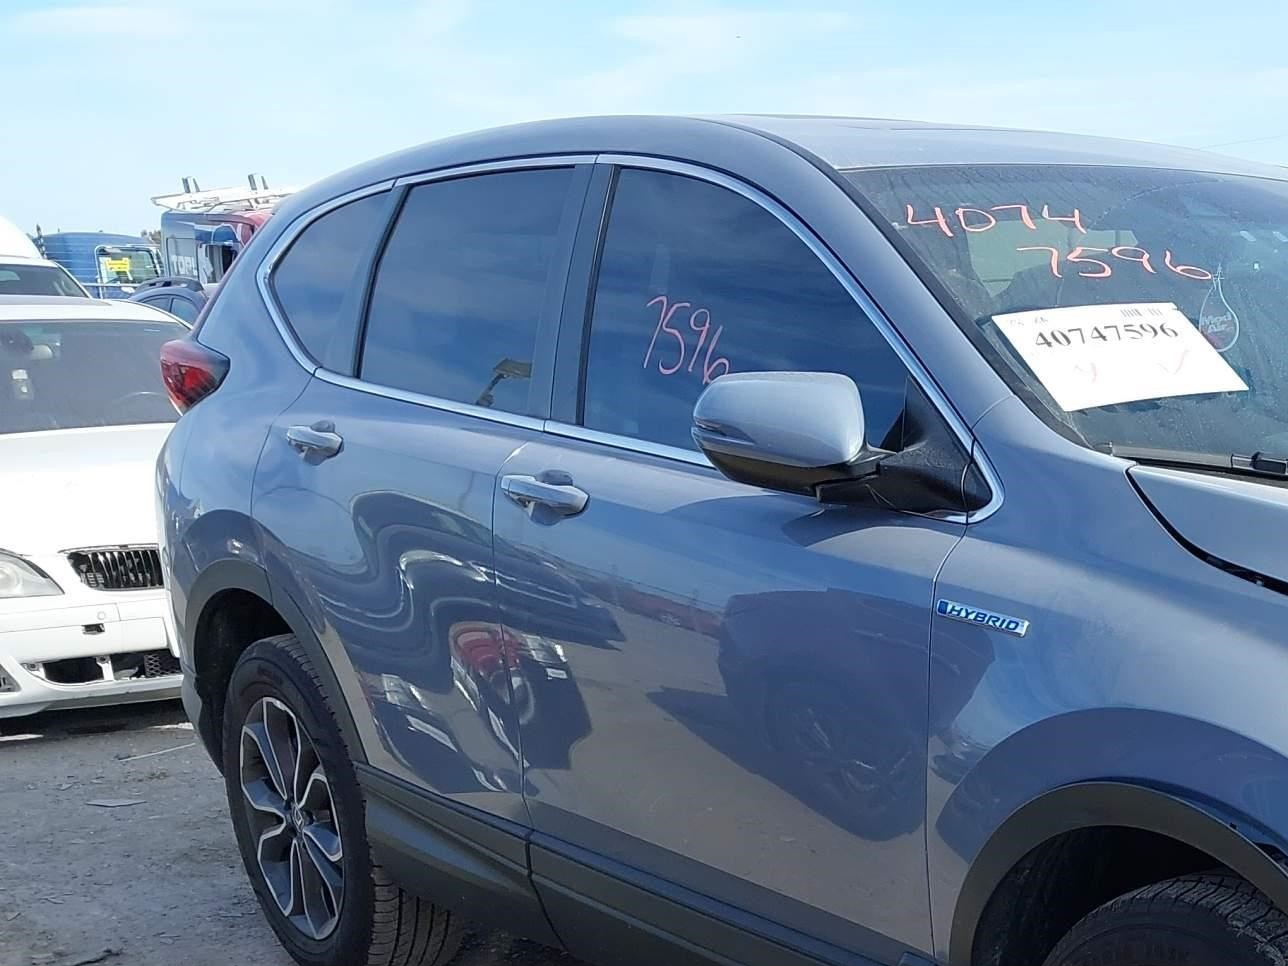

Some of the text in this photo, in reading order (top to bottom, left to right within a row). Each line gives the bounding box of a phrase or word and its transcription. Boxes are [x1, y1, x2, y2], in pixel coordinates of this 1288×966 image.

[906, 203, 1088, 238] 4074
[1016, 246, 1213, 280] 7596
[642, 295, 730, 385] 7596
[1035, 322, 1179, 348] 40747596
[948, 604, 1020, 631] HYBRID
